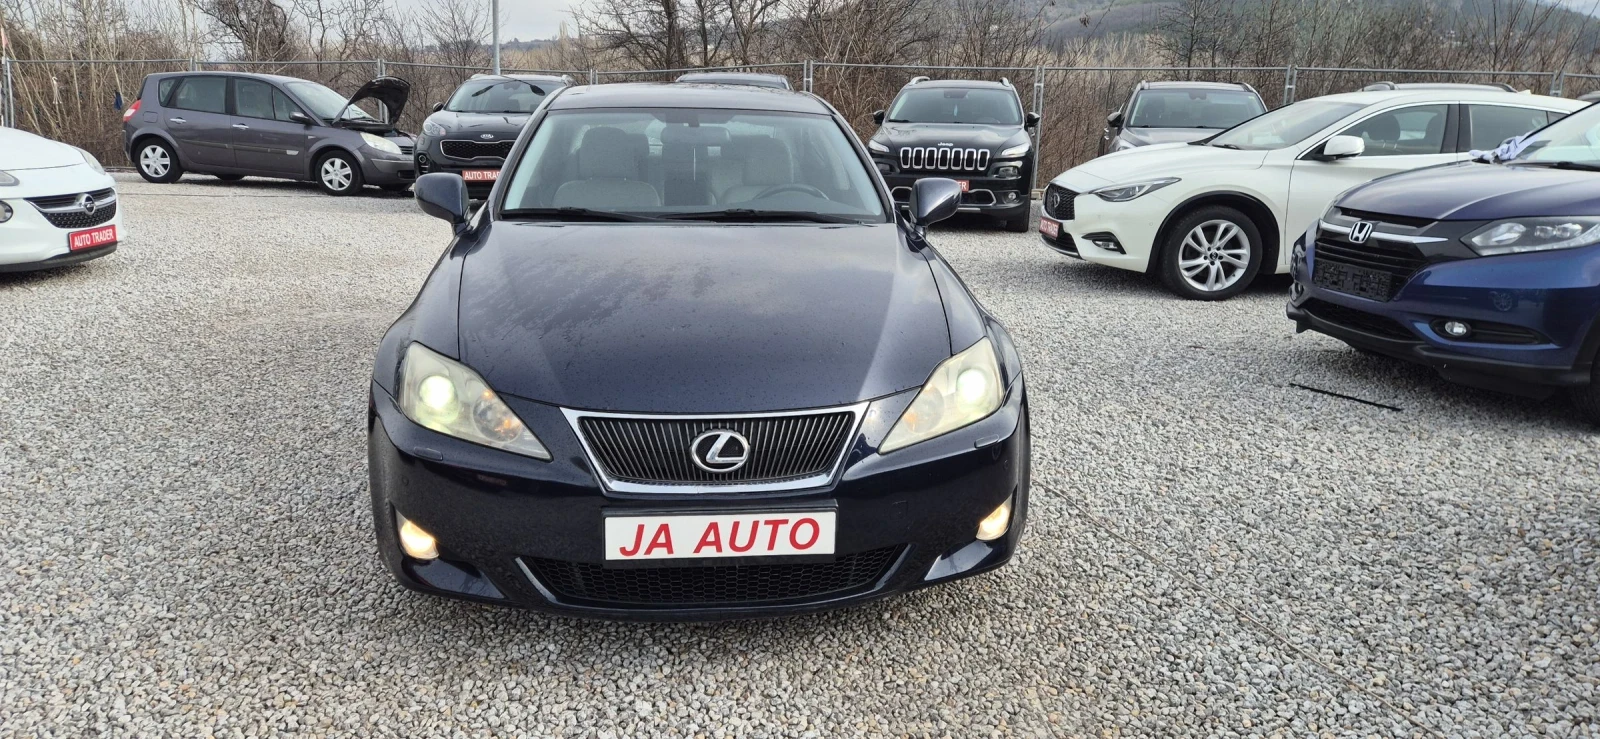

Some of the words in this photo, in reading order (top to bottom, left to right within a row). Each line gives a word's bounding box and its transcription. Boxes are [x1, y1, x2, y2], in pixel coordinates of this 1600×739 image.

[464, 171, 482, 180] AUTO
[74, 233, 92, 248] AUTO
[91, 228, 115, 244] TRADER
[619, 523, 674, 556] JA
[693, 517, 820, 553] AUTO
